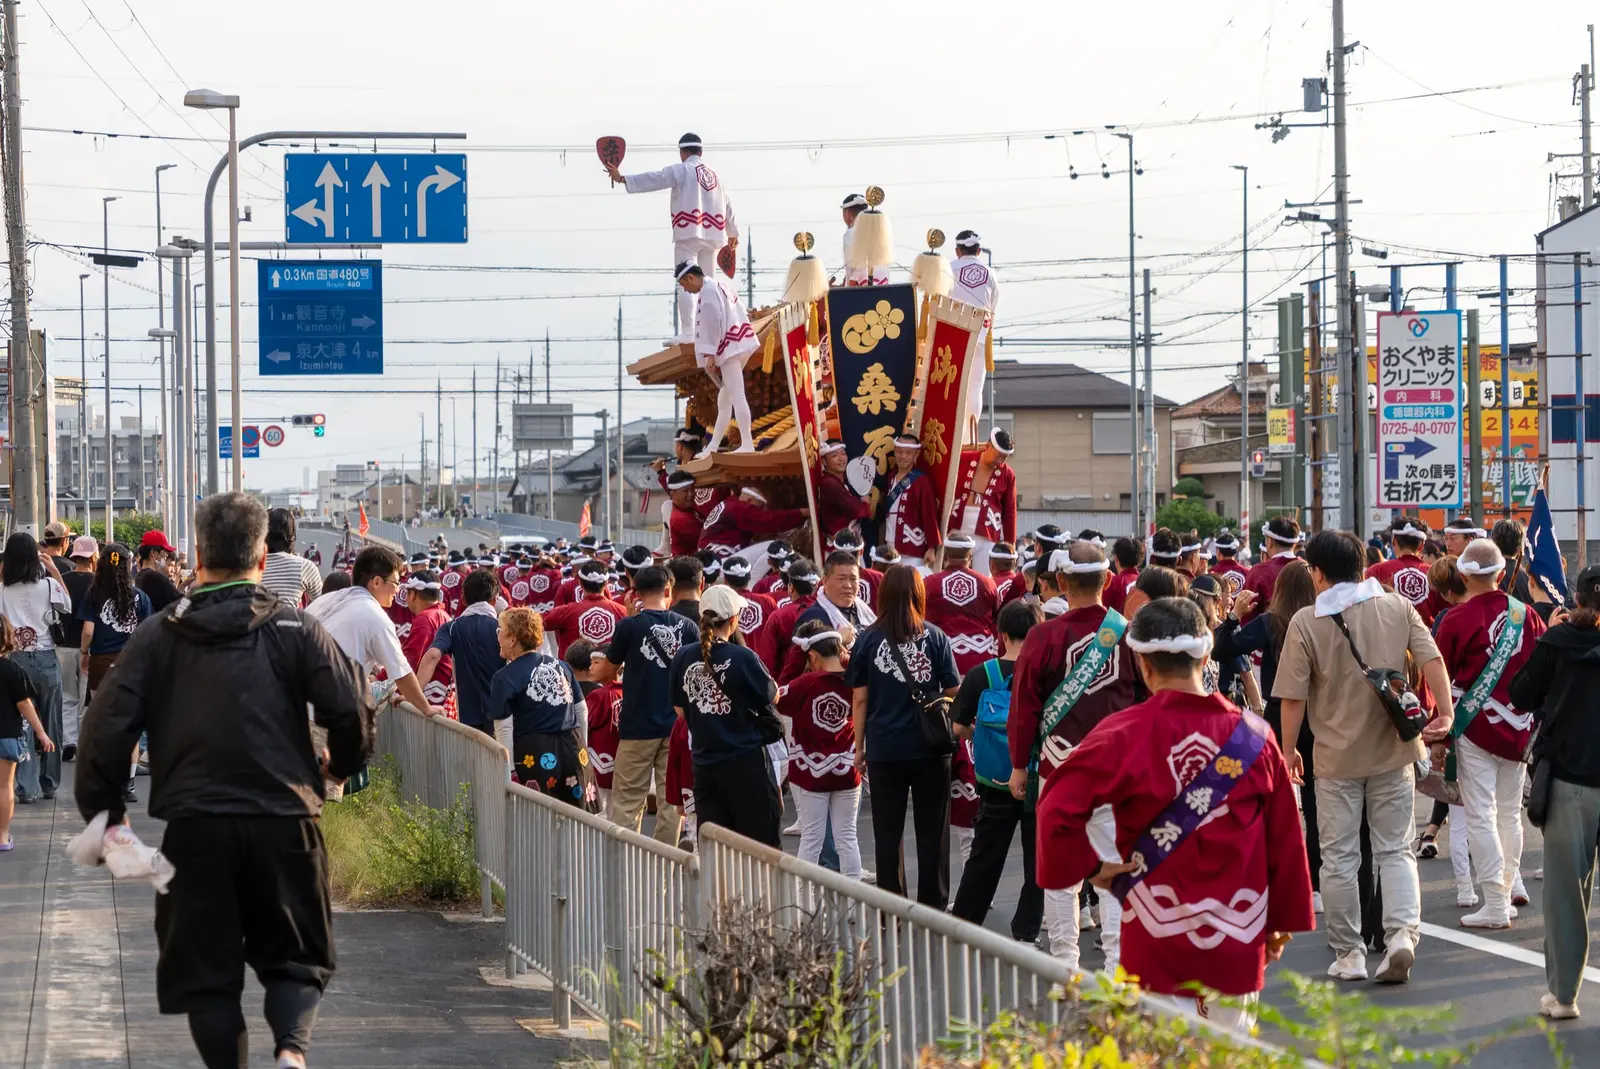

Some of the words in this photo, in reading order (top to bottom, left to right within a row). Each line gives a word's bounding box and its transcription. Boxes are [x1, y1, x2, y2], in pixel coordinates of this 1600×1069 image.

[316, 268, 369, 280] 国道480号
[268, 304, 274, 320] 1
[282, 312, 294, 321] km
[296, 304, 346, 320] 観音寺
[296, 323, 346, 333] Kannonji
[296, 342, 346, 359] 泉大津
[352, 342, 361, 359] 4
[366, 350, 379, 359] km
[1383, 345, 1455, 367] おくやま
[299, 361, 344, 371] Izumiotsu
[1383, 367, 1455, 387] クリニック
[1396, 390, 1441, 402] 内科
[1393, 406, 1445, 418] 循環器内科
[1382, 422, 1457, 435] 0725-40-0707
[267, 431, 280, 442] 60
[851, 362, 901, 519] 桑原
[1405, 464, 1456, 479] 次の信号
[1384, 481, 1457, 502] 右折スグ
[1462, 626, 1517, 713] 曳行副責任者
